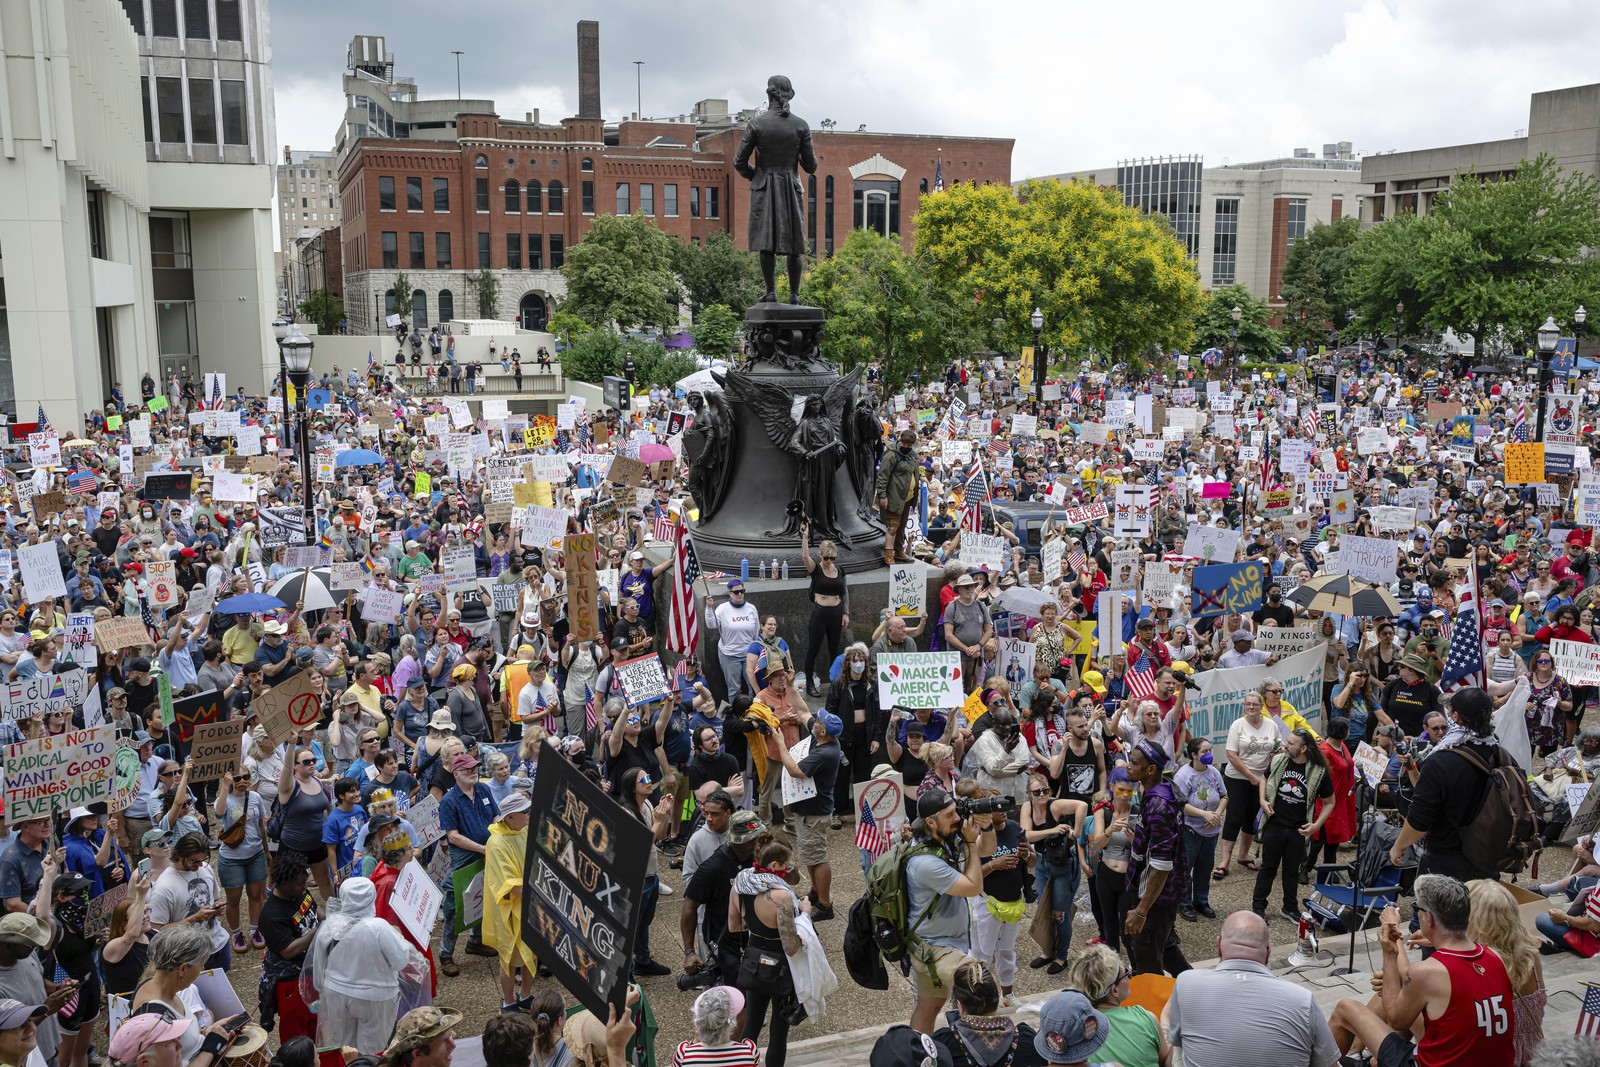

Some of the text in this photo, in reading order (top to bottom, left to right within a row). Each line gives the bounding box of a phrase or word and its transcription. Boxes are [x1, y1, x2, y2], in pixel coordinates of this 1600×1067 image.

[1546, 434, 1576, 443] JUNETEENTH
[943, 442, 960, 450] ICE
[1134, 450, 1164, 459] DICTATOR
[527, 504, 563, 519] NO HUMAN
[1067, 501, 1105, 517] THE PEOPLE
[283, 513, 303, 523] RESIST
[1070, 510, 1108, 523] WILL RISE
[534, 519, 560, 530] ILLEGAL
[569, 539, 592, 554] NO
[1364, 538, 1390, 548] KINGS
[22, 550, 32, 560] NO
[27, 554, 50, 568] FAUX
[1340, 550, 1394, 569] NO TRUMP
[38, 565, 56, 578] KING
[148, 562, 171, 574] STOP
[1148, 563, 1164, 573] Only
[1351, 570, 1380, 579] AMERICA
[894, 570, 906, 582] NO
[1145, 574, 1181, 582] BUTTERFLIES
[1230, 565, 1259, 592] NO
[375, 590, 394, 600] Cruelty
[576, 554, 590, 638] KINGS
[1229, 581, 1262, 614] KING
[372, 602, 393, 611] Christian
[65, 634, 92, 643] JUSTICE
[102, 629, 116, 637] FOR
[71, 642, 84, 650] FOR
[105, 634, 148, 647] TO ASSEMBLE
[1006, 641, 1026, 654] YOU
[64, 651, 93, 663] ALL
[878, 653, 959, 665] IMMIGRANTS
[626, 663, 654, 677] LIBERTY
[902, 667, 939, 679] MAKE
[630, 669, 659, 686] JUSTICE
[646, 677, 660, 686] ALL
[890, 681, 950, 695] AMERICA
[1188, 676, 1306, 709] THE PEOPLE WILL
[898, 695, 941, 708] GREAT
[3, 702, 40, 720] HURTS
[44, 701, 60, 712] NO
[198, 724, 239, 740] TODOS
[10, 742, 28, 758] IT
[38, 738, 52, 752] IS
[66, 728, 100, 747] NOT
[196, 743, 237, 759] SOMOS
[6, 751, 68, 774] RADICAL
[83, 742, 104, 755] TO
[5, 756, 111, 788] WANT GOOD
[192, 760, 235, 780] FAMILIA
[6, 770, 109, 801] THINGS FOR
[112, 781, 141, 813] STAY FREE!
[561, 788, 610, 854] NO
[544, 819, 622, 914] FAUX
[534, 857, 616, 960] KING
[1474, 994, 1508, 1038] 45
